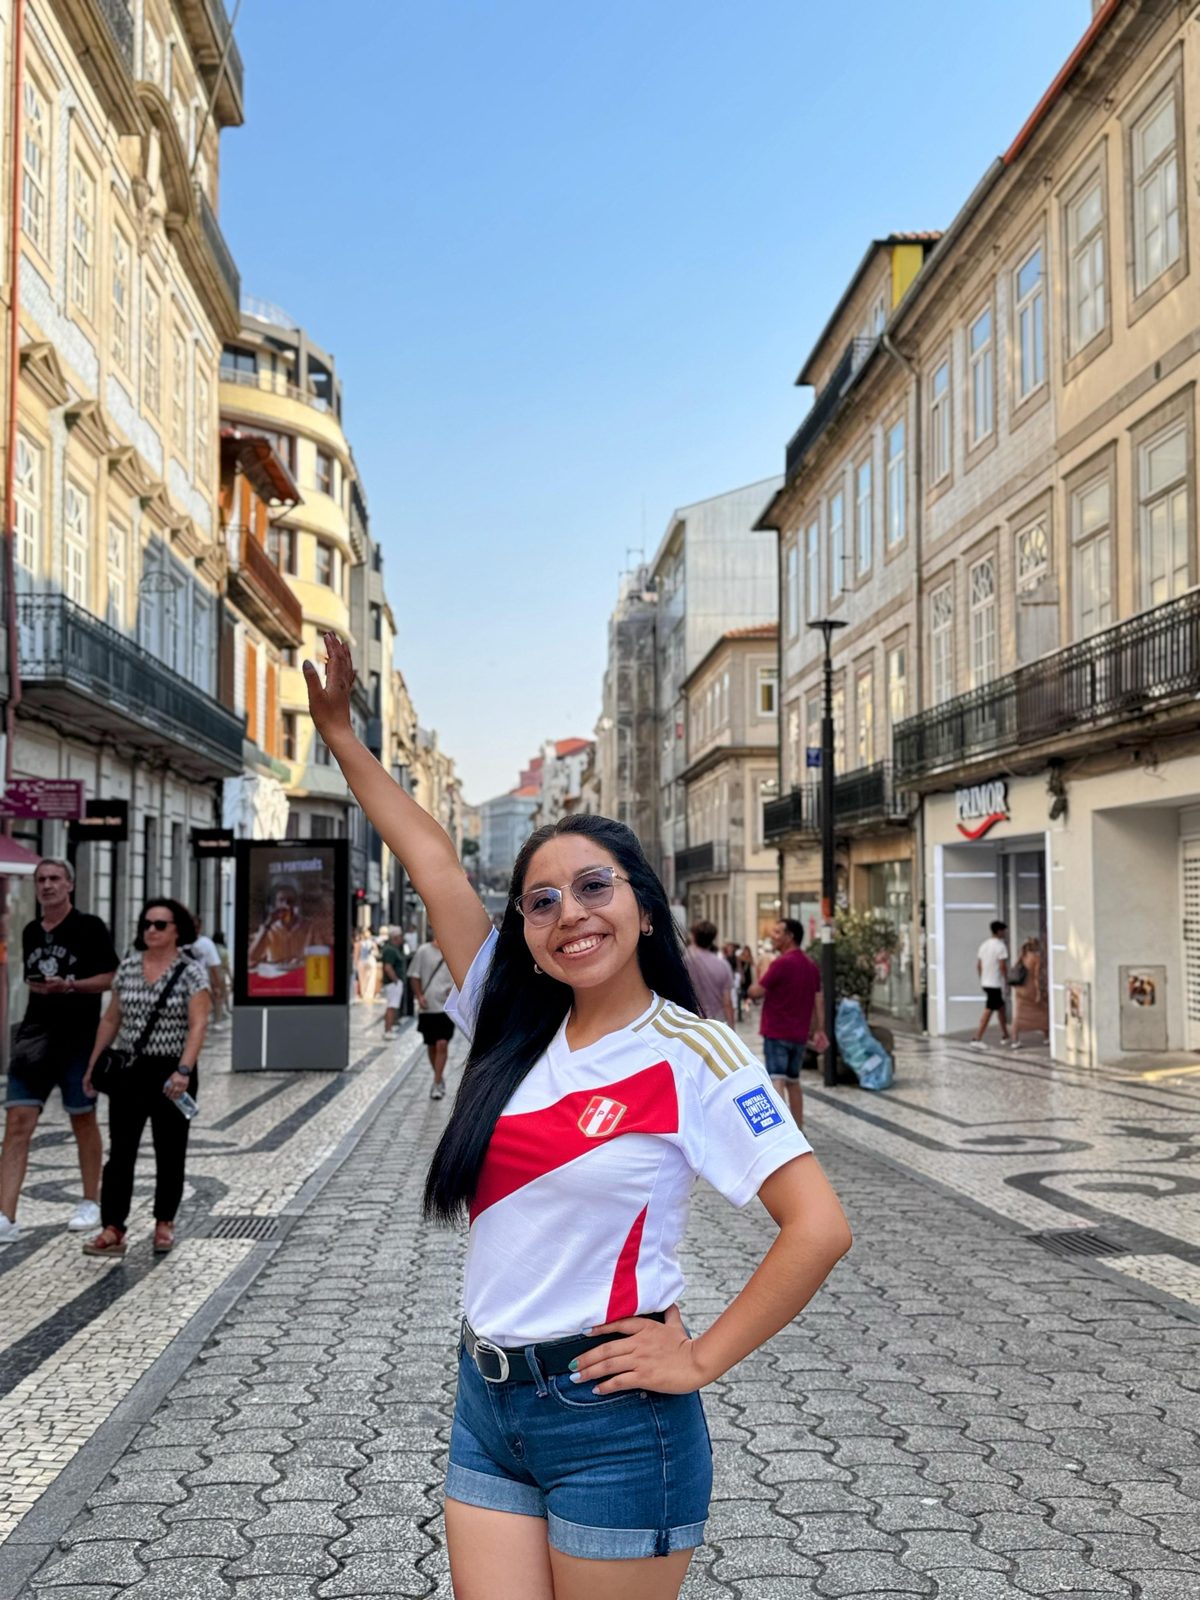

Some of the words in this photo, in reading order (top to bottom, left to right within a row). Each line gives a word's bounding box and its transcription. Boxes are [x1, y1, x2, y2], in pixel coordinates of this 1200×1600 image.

[955, 781, 1007, 819] PRIMOR
[742, 1093, 765, 1109] FOOTBALL
[746, 1099, 770, 1117] UNITES
